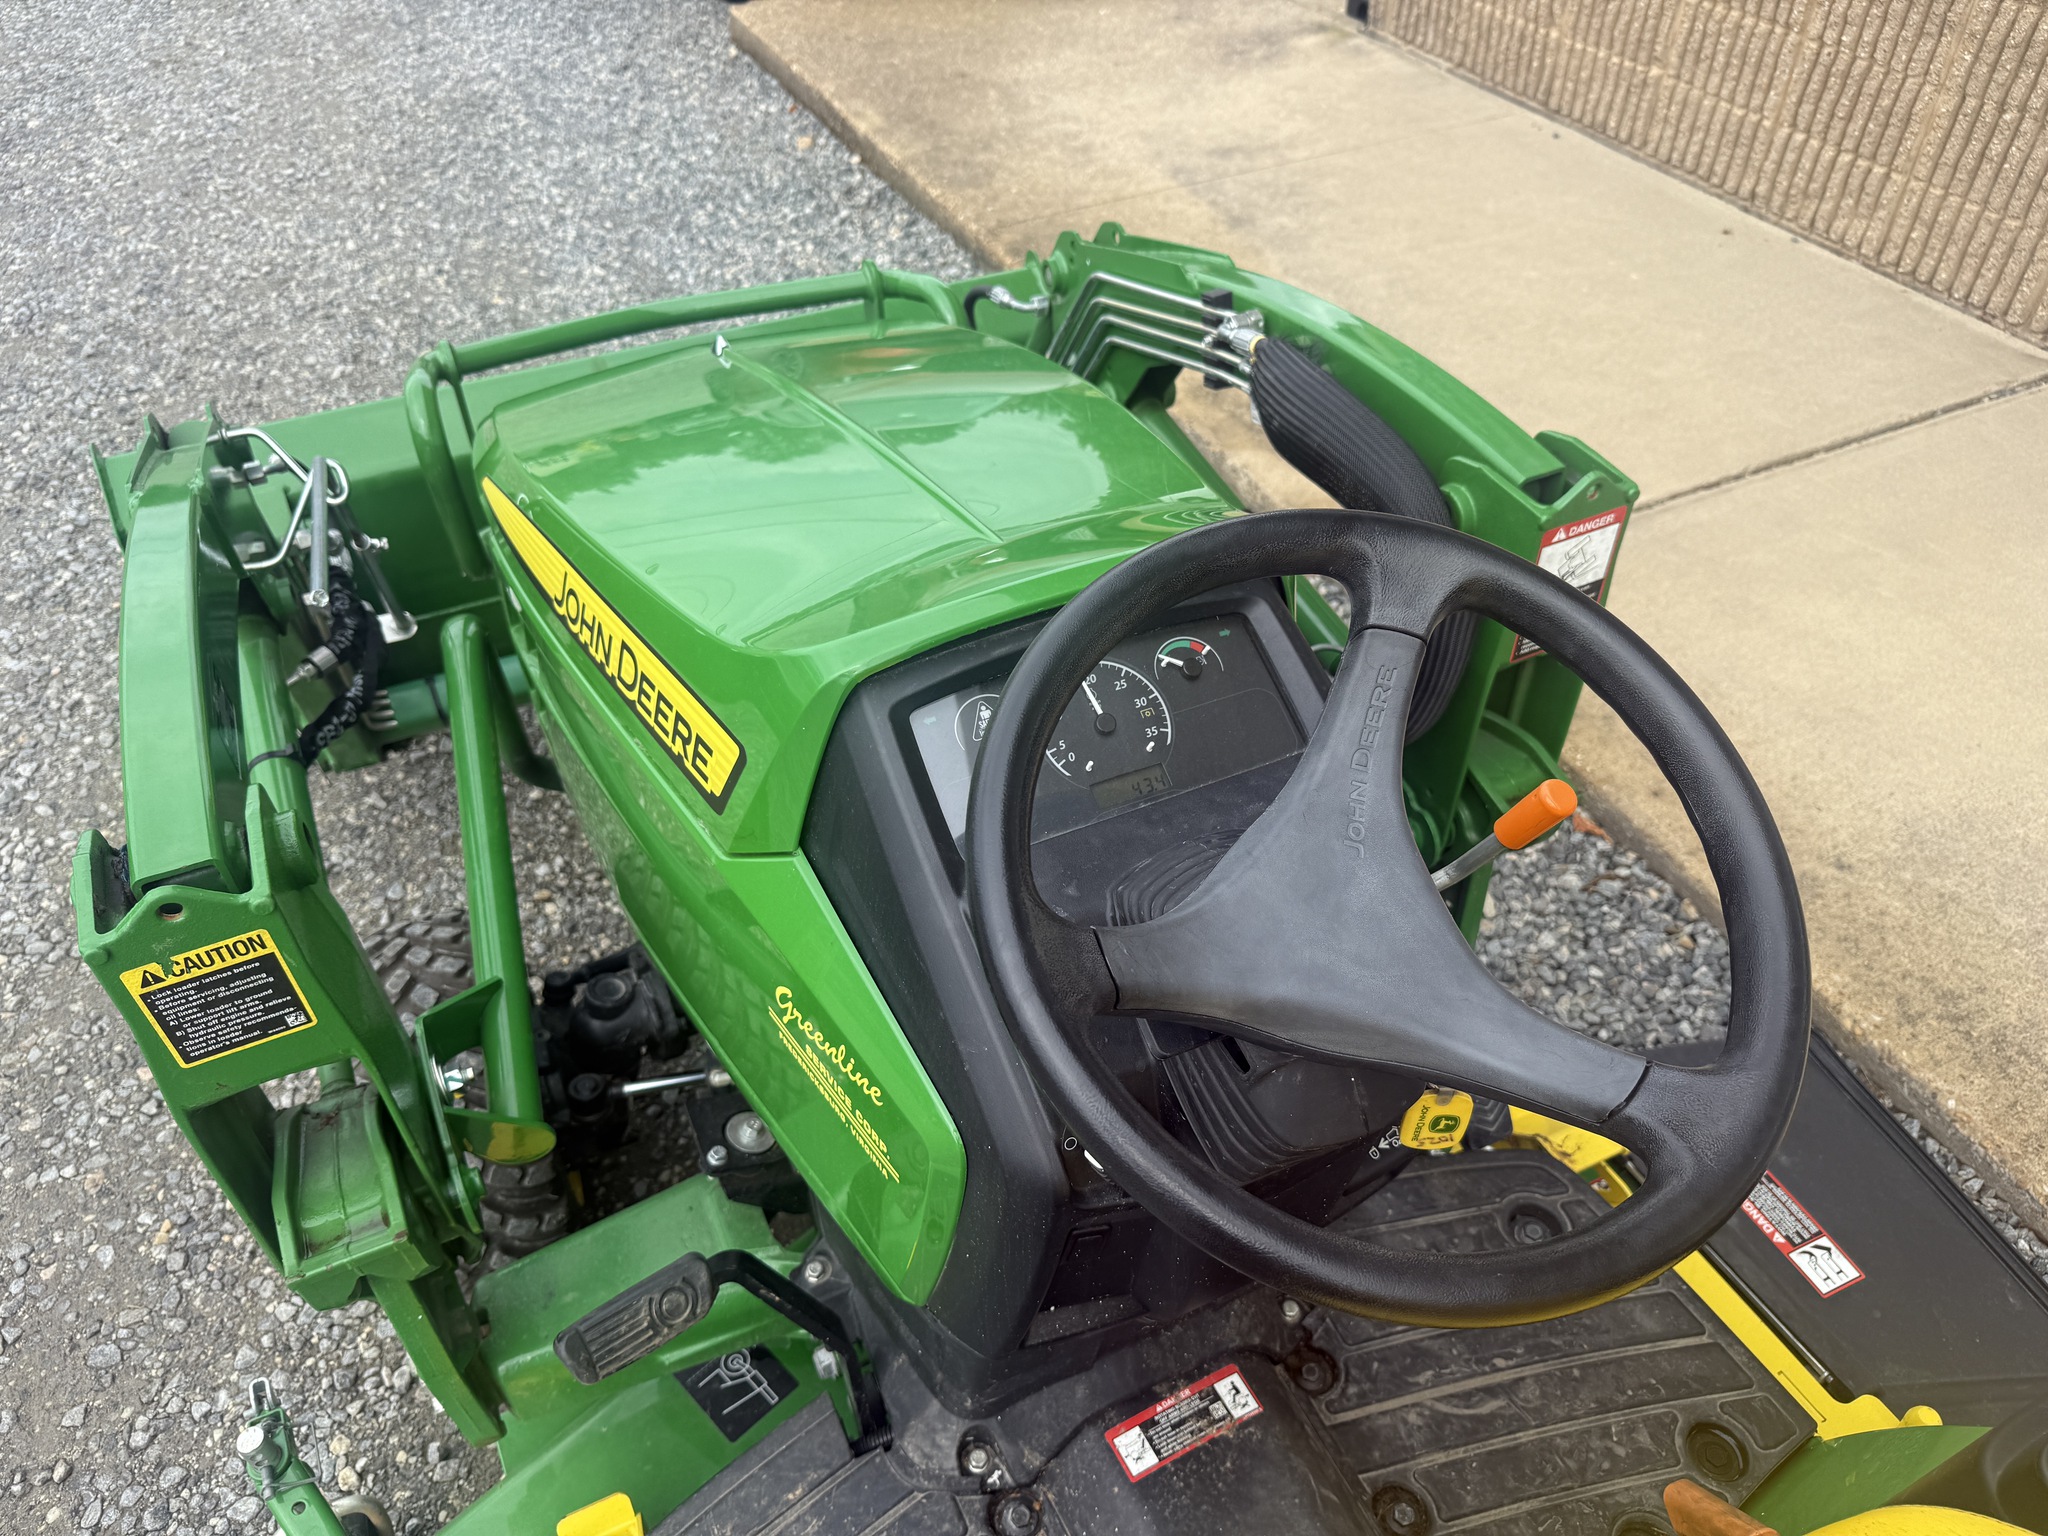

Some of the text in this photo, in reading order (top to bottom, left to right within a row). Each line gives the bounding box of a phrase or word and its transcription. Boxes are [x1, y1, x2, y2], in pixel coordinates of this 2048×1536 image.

[1568, 514, 1616, 536] DANGER
[554, 571, 714, 785] JOHN DEERE
[1114, 679, 1127, 690] 25
[1134, 697, 1147, 708] 30
[1059, 740, 1066, 750] 5
[1144, 726, 1158, 738] 35
[1068, 752, 1075, 762] 0
[1343, 664, 1398, 859] JOHN DEERE
[1131, 776, 1167, 796] 43.4
[172, 934, 268, 977] CAUTION
[151, 962, 260, 1000] Lock loader latches before
[158, 999, 186, 1010] Before
[229, 973, 267, 988] adjusting
[155, 990, 197, 1005] operating.
[162, 998, 206, 1016] equipment
[218, 977, 274, 997] disconnecting
[180, 1012, 205, 1023] Lower
[206, 1002, 233, 1014] loader
[245, 989, 273, 1002] ground
[178, 1007, 200, 1017] lines:
[183, 1007, 297, 1047] Observe safety recommenda-
[187, 1024, 206, 1033] Shut
[207, 1019, 219, 1027] off
[220, 1010, 247, 1022] engine
[249, 1005, 264, 1013] and
[265, 996, 292, 1007] relieve
[189, 1012, 265, 1039] hydraulic pressure.
[194, 1011, 225, 1025] support
[240, 1001, 262, 1010] arms.
[186, 1043, 207, 1052] tions
[217, 1030, 243, 1041] loader
[190, 1041, 231, 1057] operator's
[232, 1029, 263, 1043] manual.
[775, 986, 884, 1106] Greenline
[779, 1031, 889, 1180] FREDERICKSBURG, VIRGINIA
[805, 1044, 891, 1160] SERVICE CORP.
[1411, 1105, 1430, 1142] JOHN DEERE
[1742, 1201, 1775, 1234] DANG
[1161, 1388, 1191, 1408] DANER
